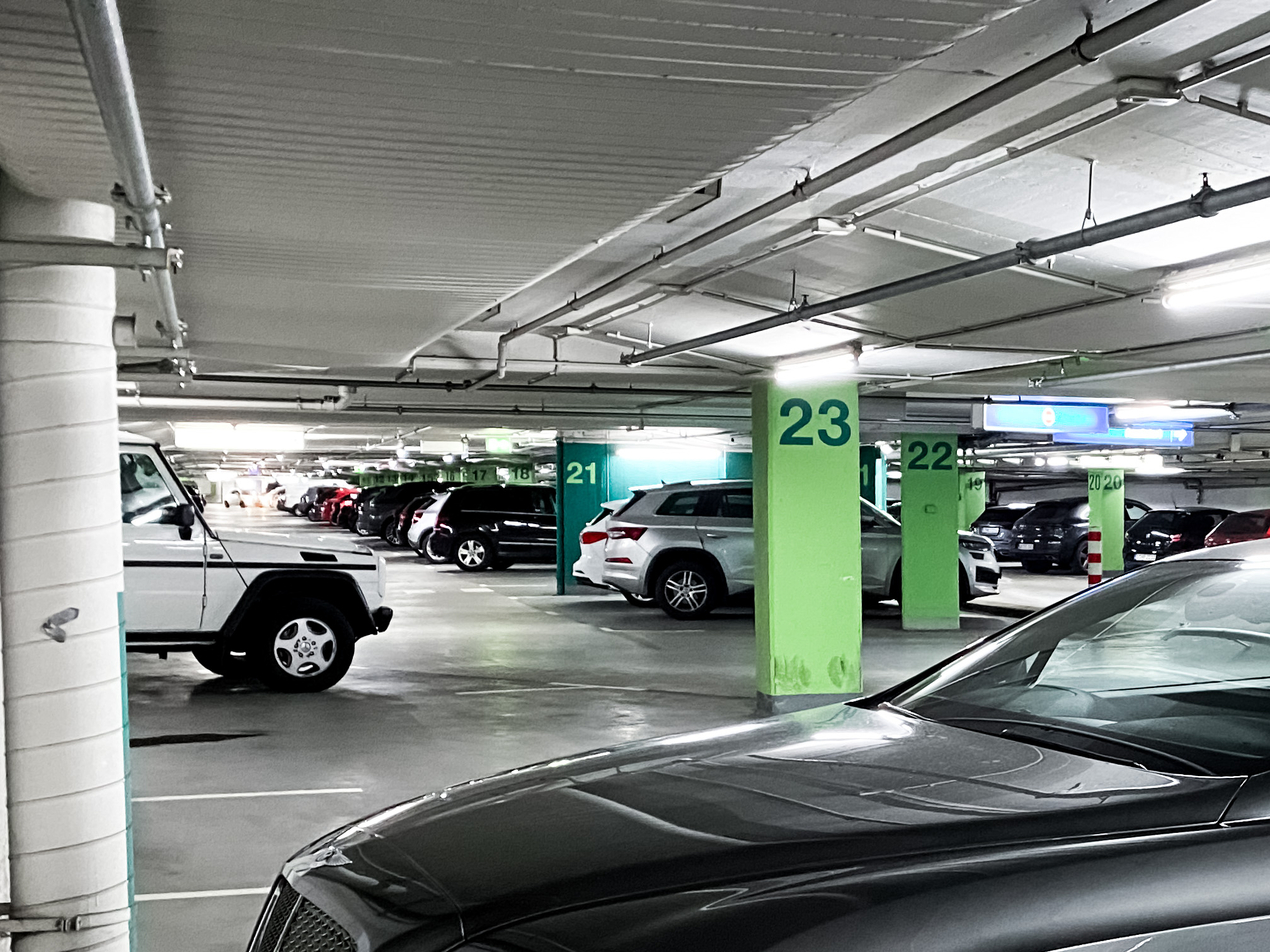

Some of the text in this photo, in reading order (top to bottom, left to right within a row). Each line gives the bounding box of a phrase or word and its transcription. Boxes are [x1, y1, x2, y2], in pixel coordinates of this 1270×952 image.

[780, 397, 852, 447] 23
[908, 440, 952, 470] 22
[472, 470, 487, 480] 17
[512, 467, 530, 480] 18
[567, 461, 596, 484] 21
[967, 477, 983, 490] 19
[1090, 474, 1101, 490] 20
[1104, 474, 1122, 490] 20
